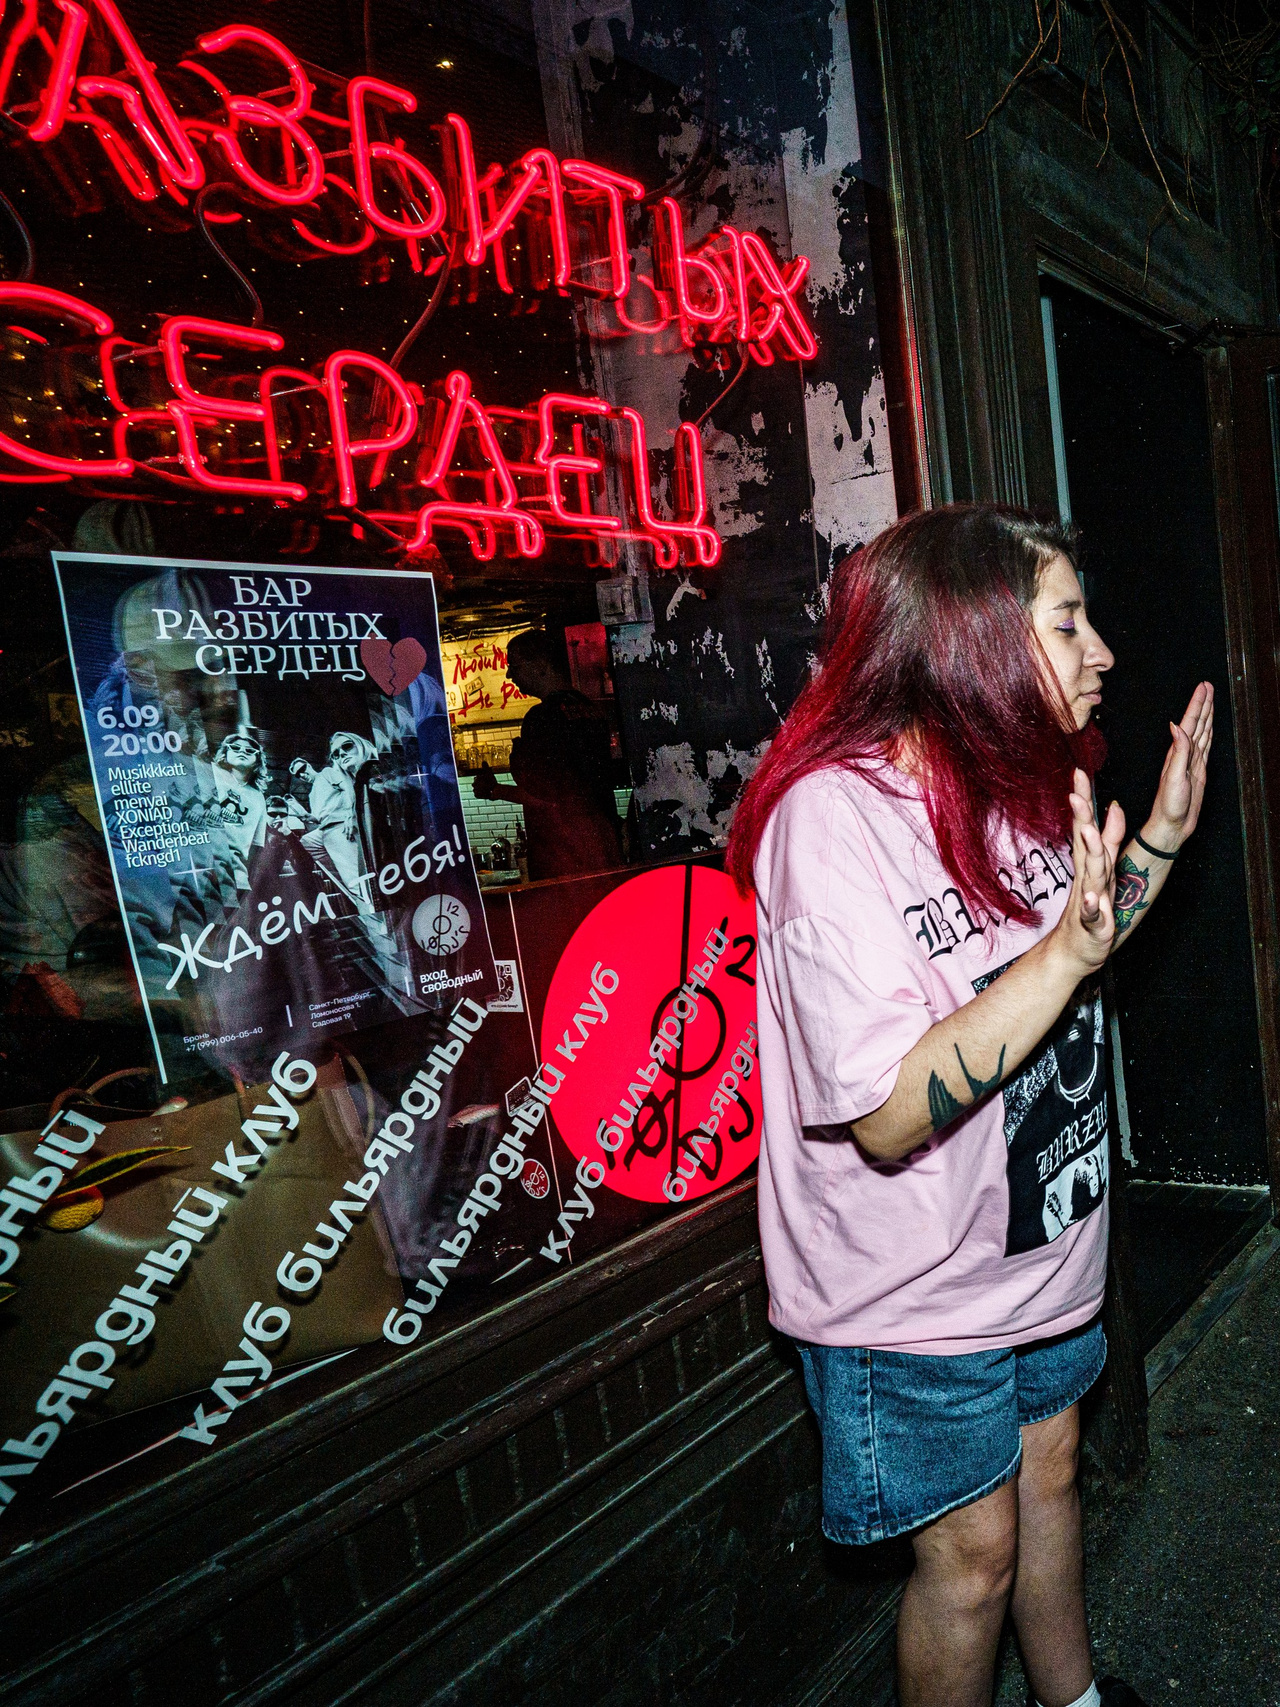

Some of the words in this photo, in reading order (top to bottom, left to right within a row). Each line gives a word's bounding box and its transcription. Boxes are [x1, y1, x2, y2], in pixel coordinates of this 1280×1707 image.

[0, 0, 818, 362] АЗБИТЫХ
[230, 575, 312, 607] БАР
[151, 608, 387, 641] РАЗБИТЫХ
[195, 643, 366, 682] СЕРДЕЦ
[97, 705, 160, 729] 6.09
[102, 731, 182, 757] 20:00
[108, 763, 187, 782] Musikkkatt
[114, 791, 168, 810] menyai
[115, 806, 173, 825] XONIAD
[120, 820, 190, 840] Exception
[122, 831, 211, 853] Wanderbeat
[158, 893, 340, 990] Ждём
[354, 825, 466, 913] тебя!
[420, 969, 448, 984] ВХОД
[421, 969, 484, 994] СВОБОДНЫЙ
[311, 1004, 355, 1019] Ломоносова
[312, 1015, 343, 1028] Садовая
[183, 1032, 210, 1044] Бронь
[186, 1043, 196, 1052] +7
[540, 1155, 605, 1265] клуб
[595, 927, 731, 1153] бильярдный
[211, 1051, 317, 1183] клуб
[382, 1063, 566, 1346] бильярдный
[555, 961, 620, 1063] клуб
[179, 1301, 291, 1446] клуб
[276, 997, 488, 1294] бильярдный
